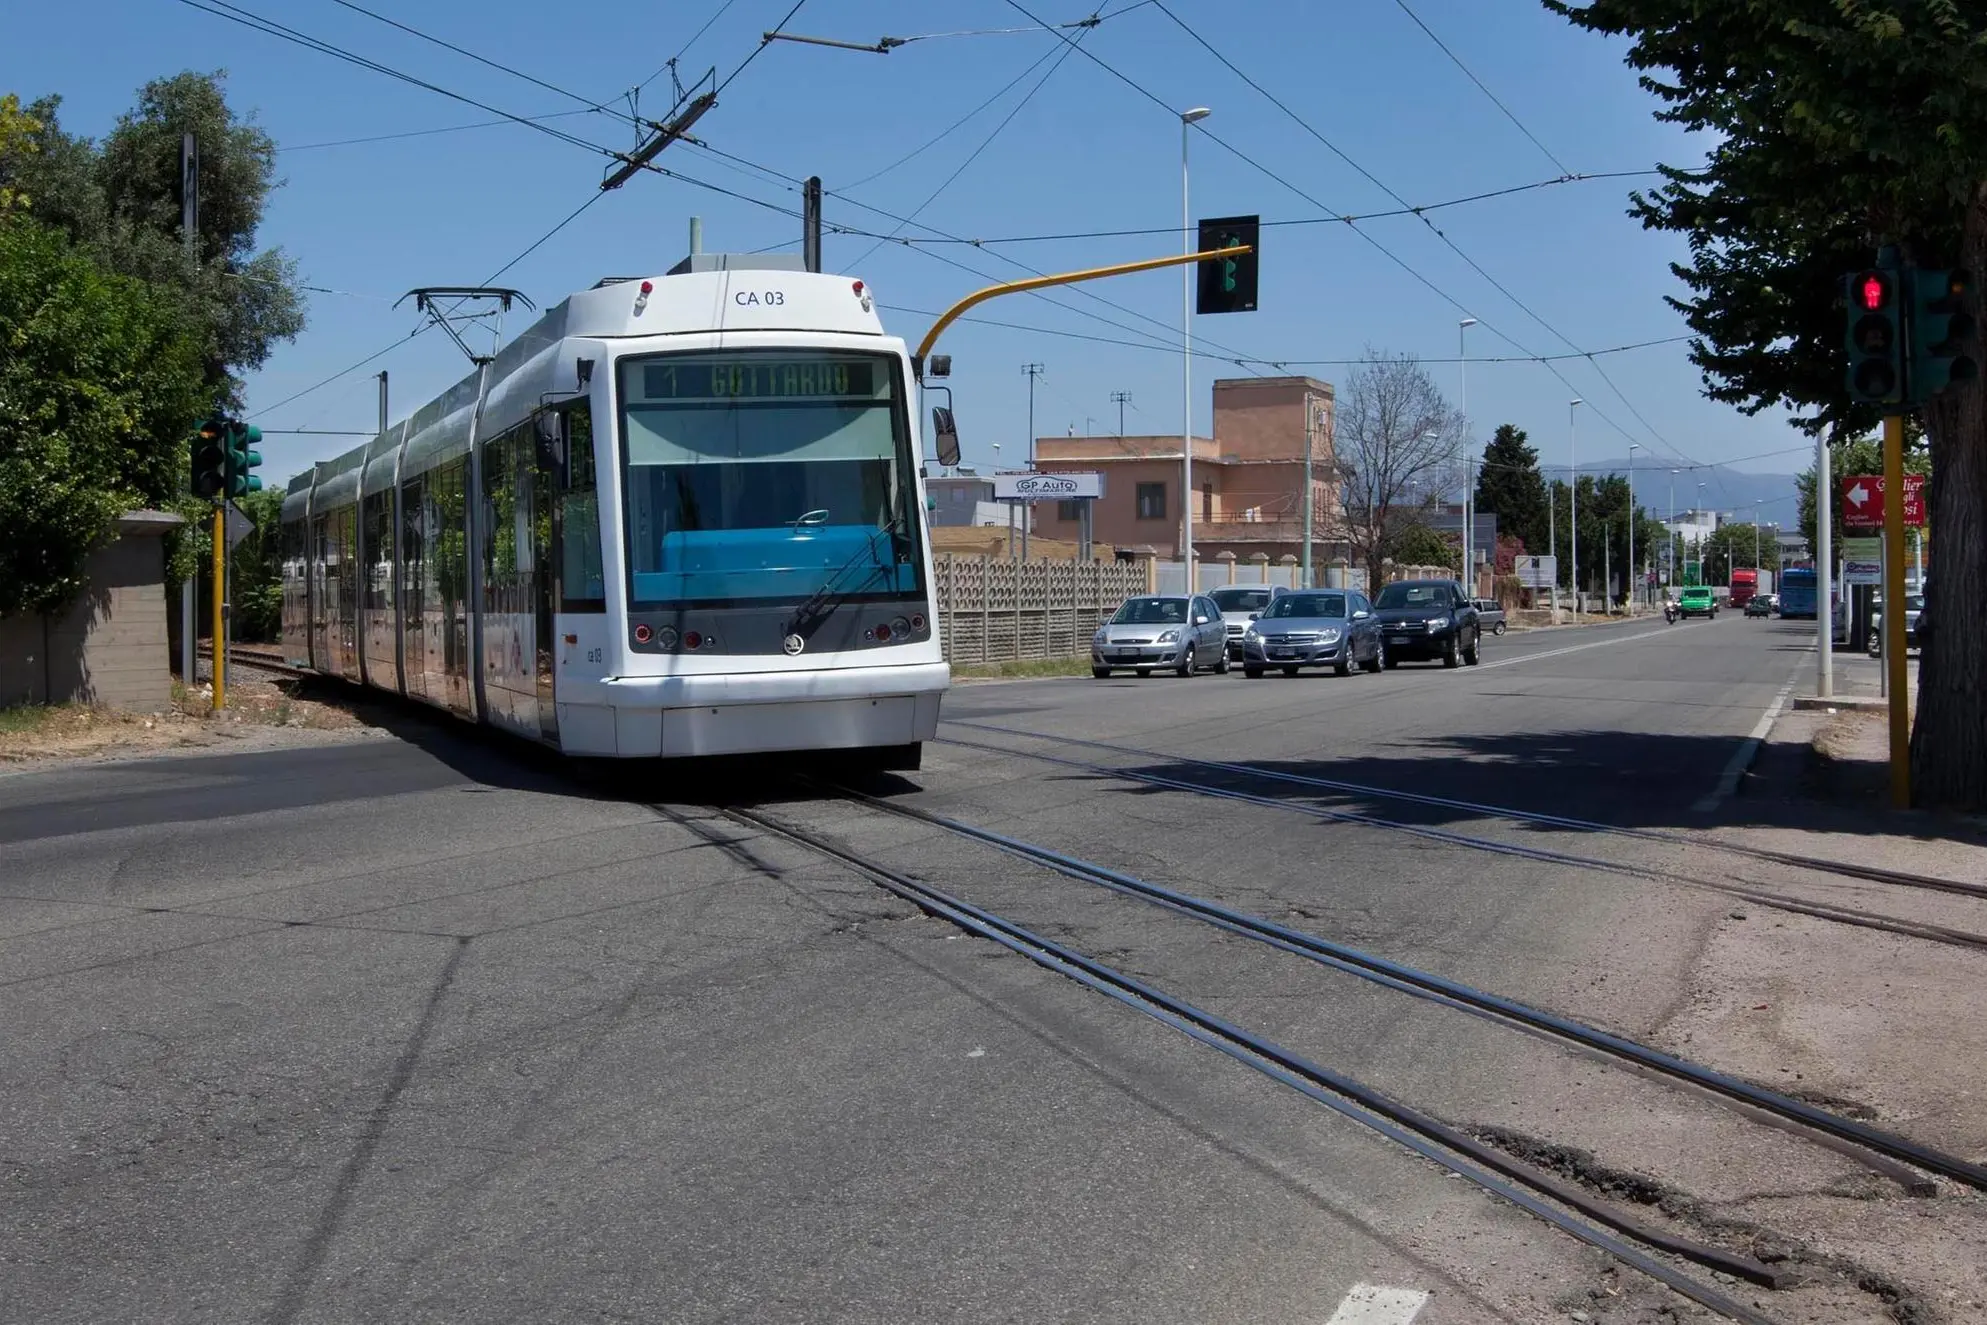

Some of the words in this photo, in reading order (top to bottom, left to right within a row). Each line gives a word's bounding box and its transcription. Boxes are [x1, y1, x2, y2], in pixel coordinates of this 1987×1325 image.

[735, 291, 760, 306] CA
[764, 291, 784, 306] 03
[663, 365, 677, 397] 1
[711, 363, 849, 397] GOTTARDO
[1021, 481, 1038, 490] GP
[1042, 481, 1073, 489] Auto
